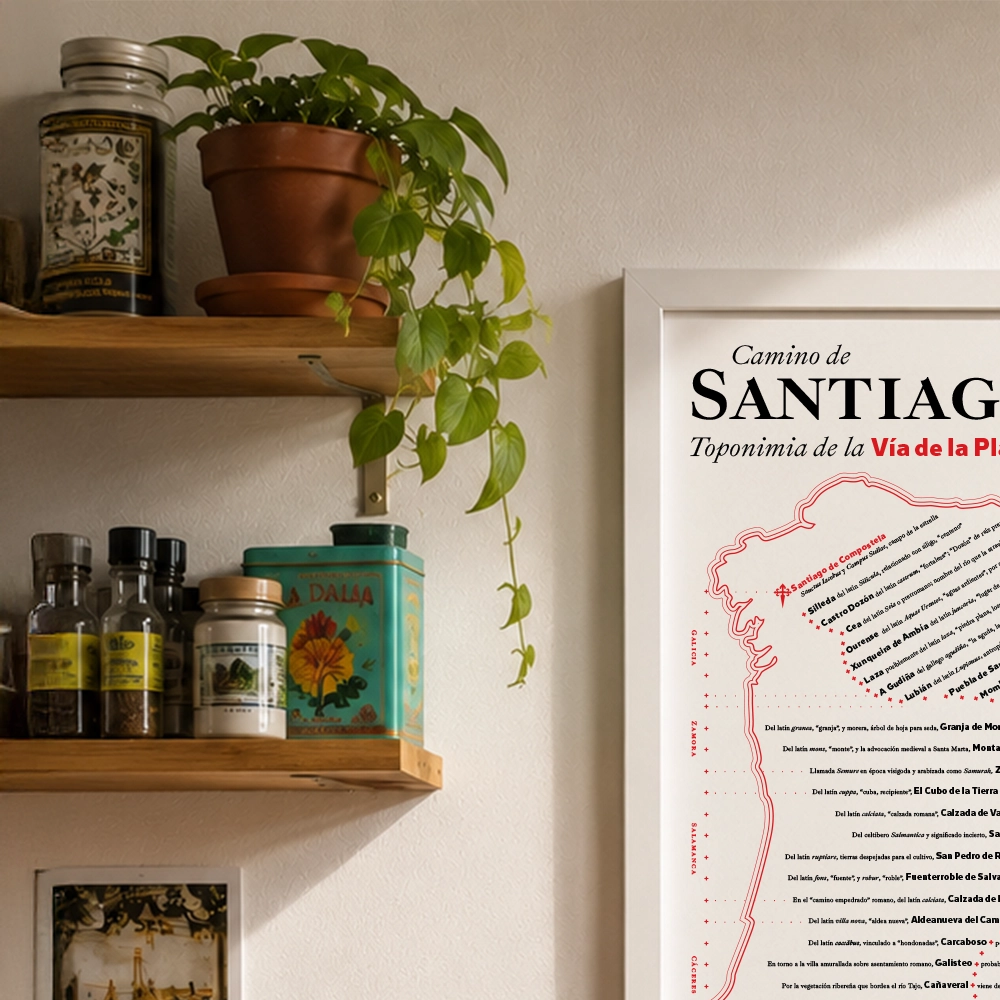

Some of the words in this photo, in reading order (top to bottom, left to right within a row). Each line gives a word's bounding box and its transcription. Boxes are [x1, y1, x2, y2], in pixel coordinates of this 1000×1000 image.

[732, 345, 820, 365] Camino
[826, 344, 851, 365] de
[690, 437, 807, 462] Toponimia
[813, 436, 838, 457] de
[844, 436, 864, 457] la
[870, 437, 910, 457] Vía
[914, 437, 943, 457] de
[947, 437, 969, 457] la
[790, 567, 828, 592] Santiago
[827, 561, 839, 571] de
[838, 533, 887, 564] Compostela
[807, 595, 836, 615] Silleda
[820, 608, 848, 626] Castro
[847, 593, 874, 612] Dozón
[845, 622, 862, 632] Cea
[845, 632, 879, 653] Ourense
[849, 644, 891, 671] Xunqueira
[892, 638, 902, 648] de
[902, 623, 929, 641] Ambía
[863, 669, 884, 684] Laza
[879, 688, 887, 696] A
[886, 672, 915, 690] Gudiña
[948, 676, 977, 696] Puebla
[977, 670, 988, 680] de
[904, 682, 932, 701] Lubián
[940, 722, 970, 732] Granja
[971, 722, 983, 731] de
[913, 786, 923, 795] El
[924, 786, 948, 795] Cubo
[949, 786, 961, 795] de
[961, 786, 971, 795] la
[972, 786, 999, 795] Tierra
[940, 808, 977, 817] Calzada
[977, 808, 989, 817] de
[936, 851, 953, 860] San
[954, 851, 981, 860] Pedro
[982, 851, 993, 860] de
[905, 872, 964, 881] Fuenterroble
[965, 872, 976, 881] de
[948, 894, 984, 903] Calzada
[985, 894, 997, 903] de
[911, 915, 963, 924] Aldeanueva
[964, 915, 978, 924] del
[940, 937, 987, 946] Carcaboso
[935, 958, 973, 967] Galisteo
[924, 980, 969, 989] Cañaveral
